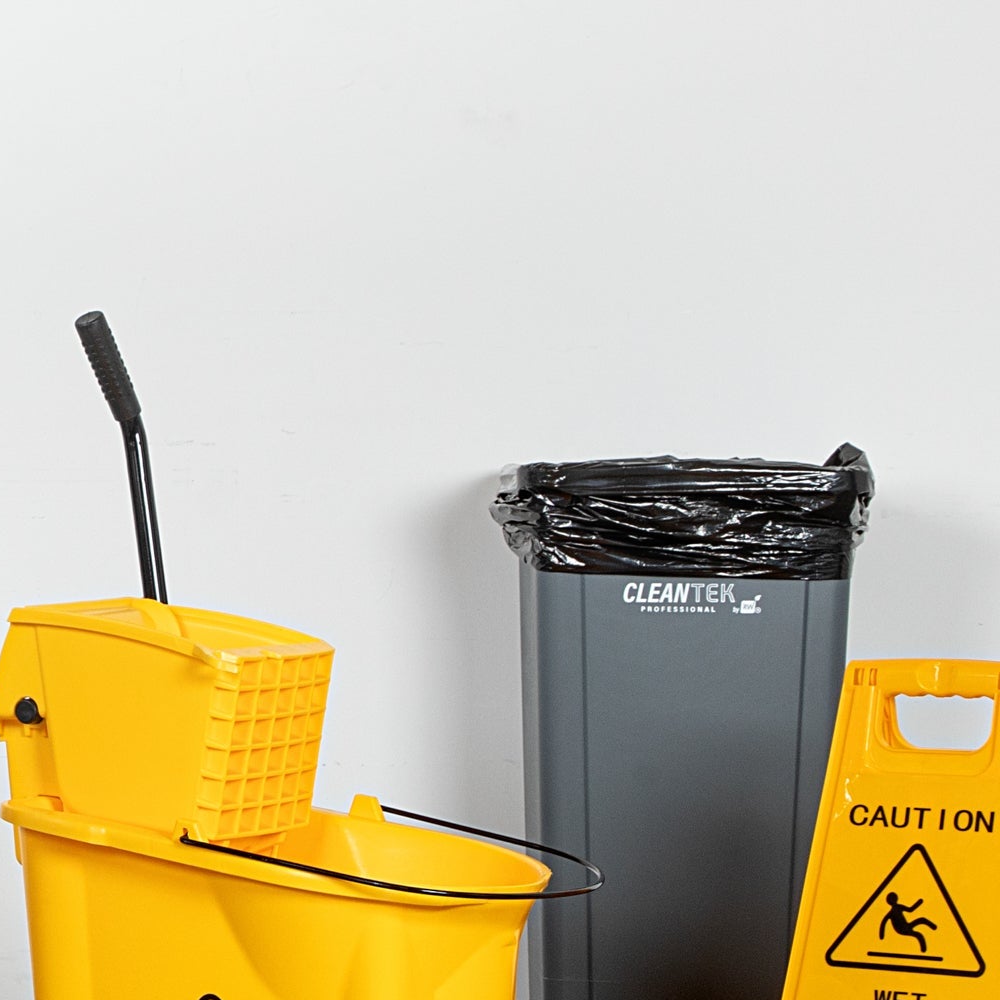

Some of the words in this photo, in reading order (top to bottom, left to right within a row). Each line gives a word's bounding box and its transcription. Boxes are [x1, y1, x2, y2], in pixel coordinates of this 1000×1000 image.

[623, 582, 736, 603] CLEANTEK
[640, 605, 716, 613] PROFESSIONAL
[849, 804, 995, 833] CAUTION
